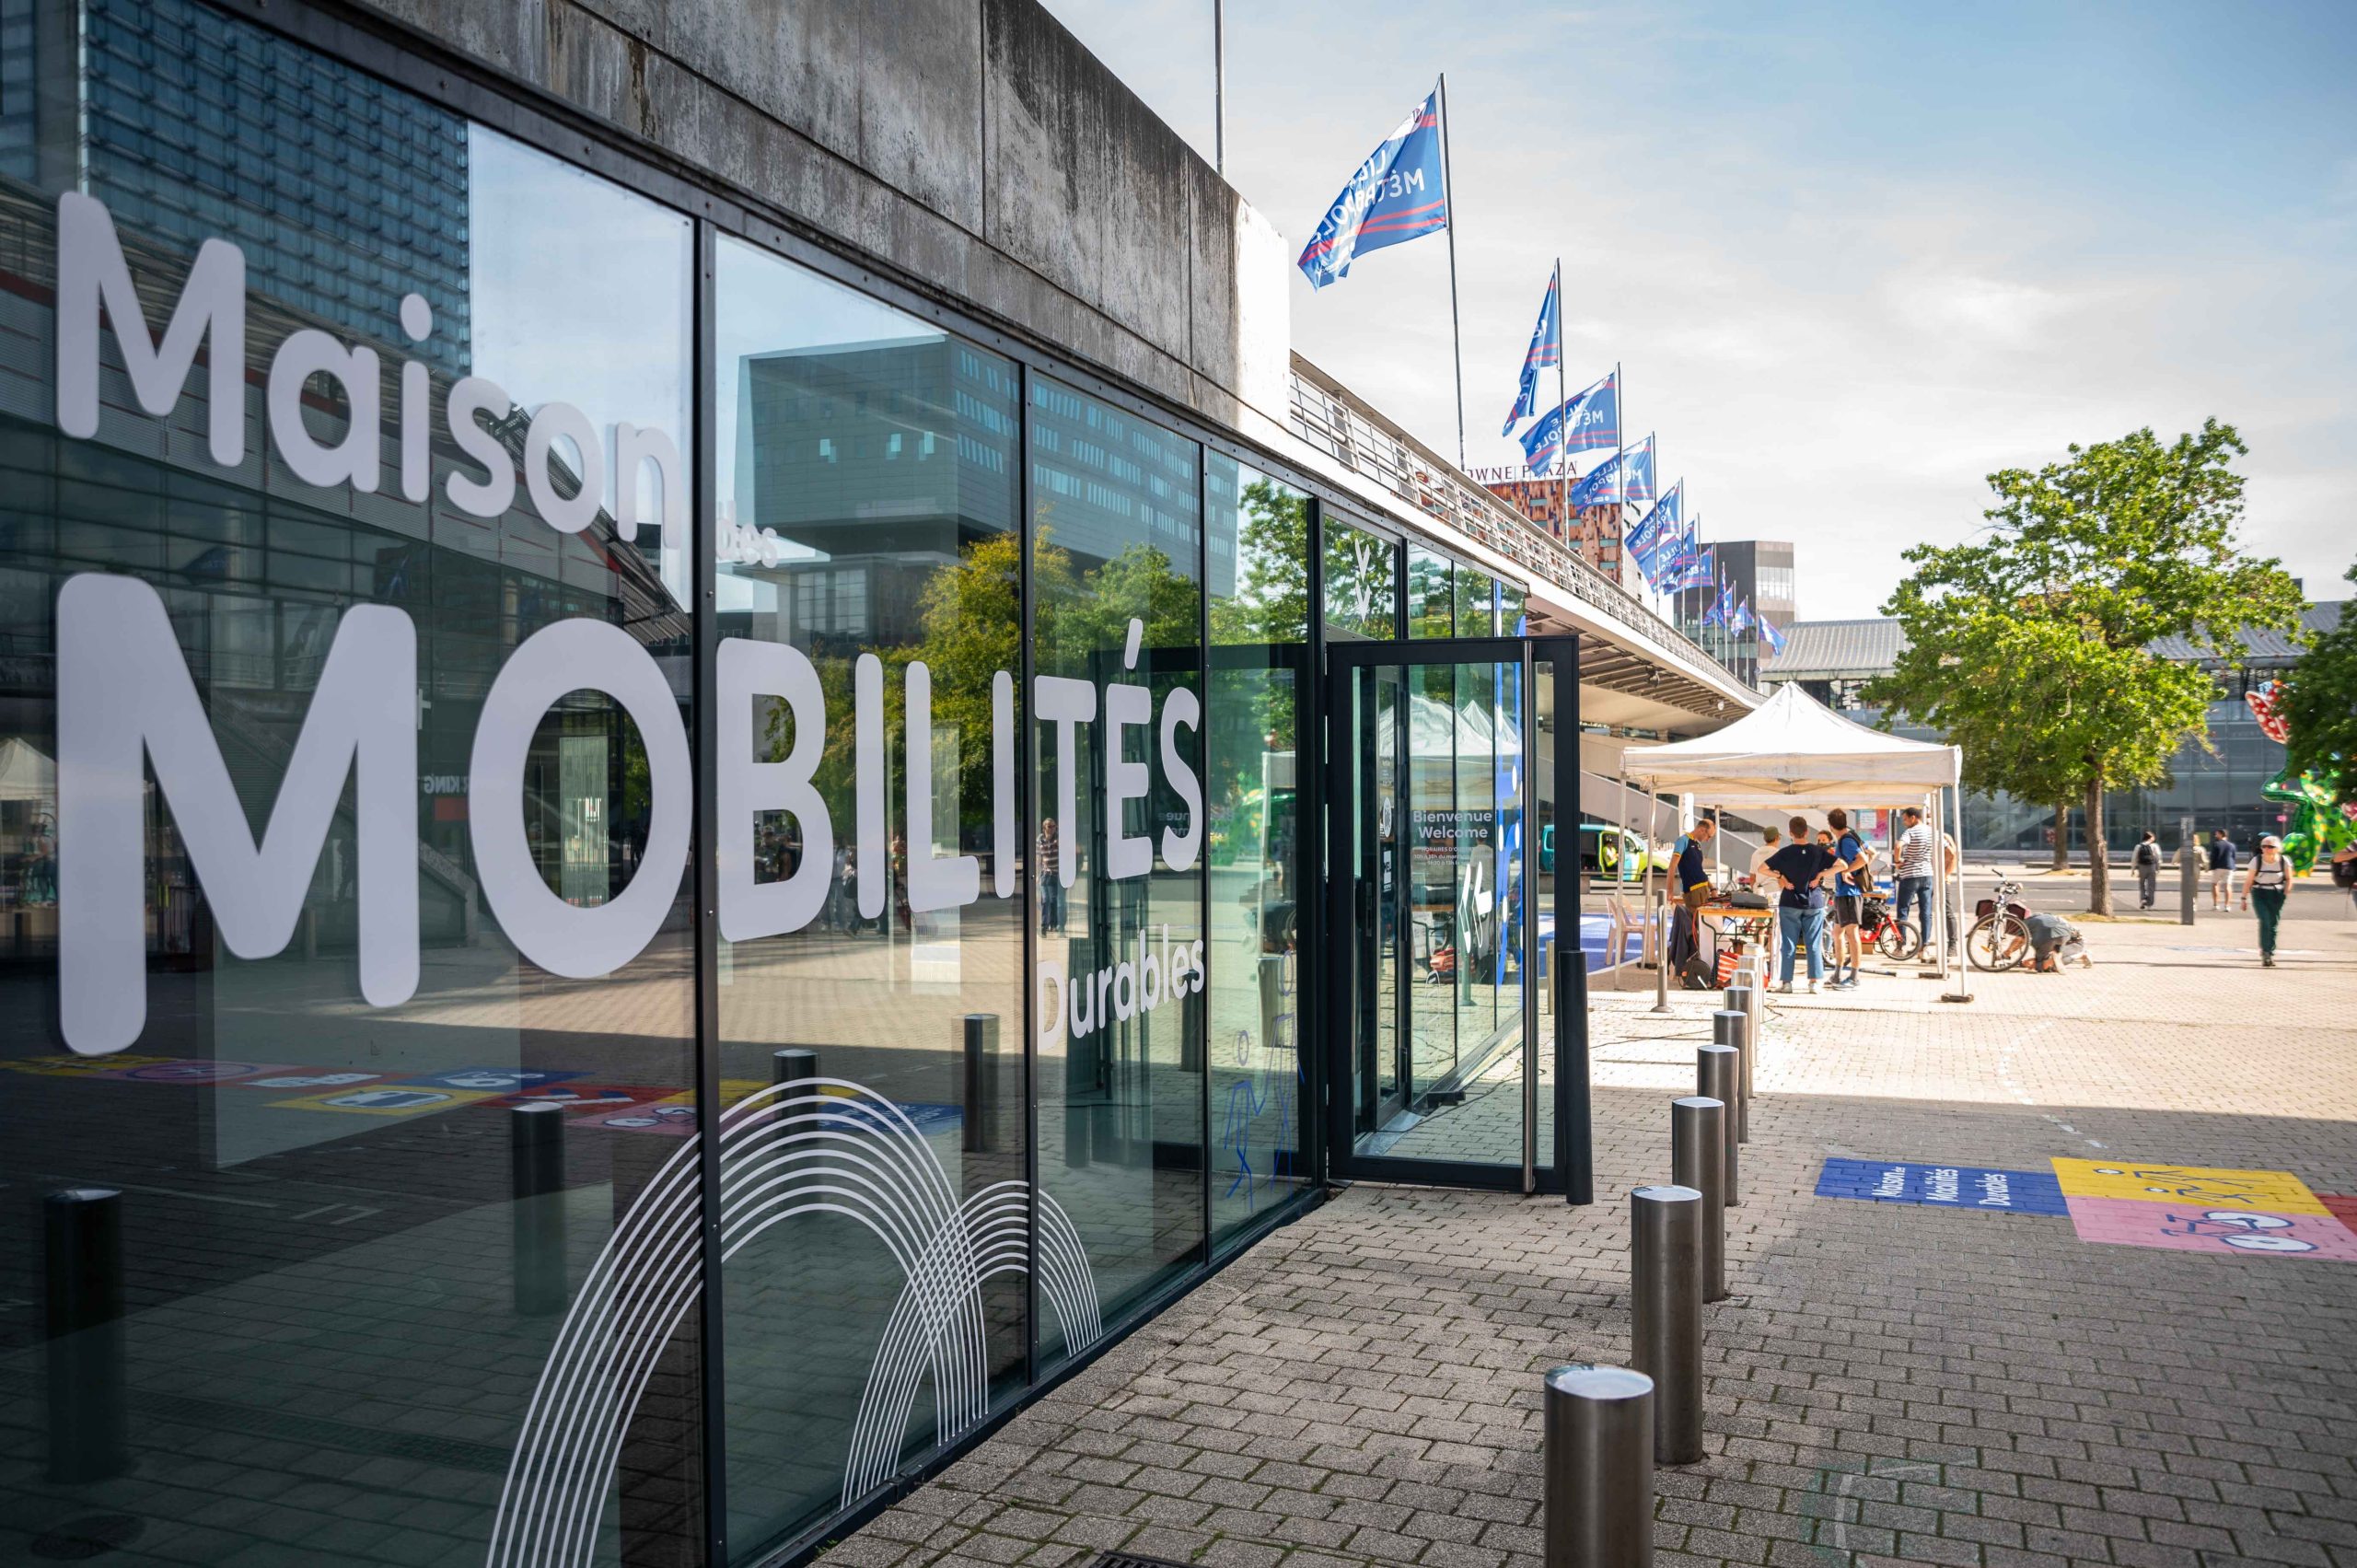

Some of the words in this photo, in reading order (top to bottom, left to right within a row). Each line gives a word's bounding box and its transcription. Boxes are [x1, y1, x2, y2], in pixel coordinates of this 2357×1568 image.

[56, 190, 682, 550] Maison
[715, 500, 778, 569] des
[56, 571, 1203, 1056] MOBILITÉS
[1413, 810, 1492, 823] Bienvenue
[1418, 825, 1489, 840] Welcome
[1036, 923, 1204, 1054] Durables
[1872, 1171, 1905, 1198] Maison
[1924, 1168, 1959, 1202] Mobilités
[1974, 1172, 2012, 1207] Durables
